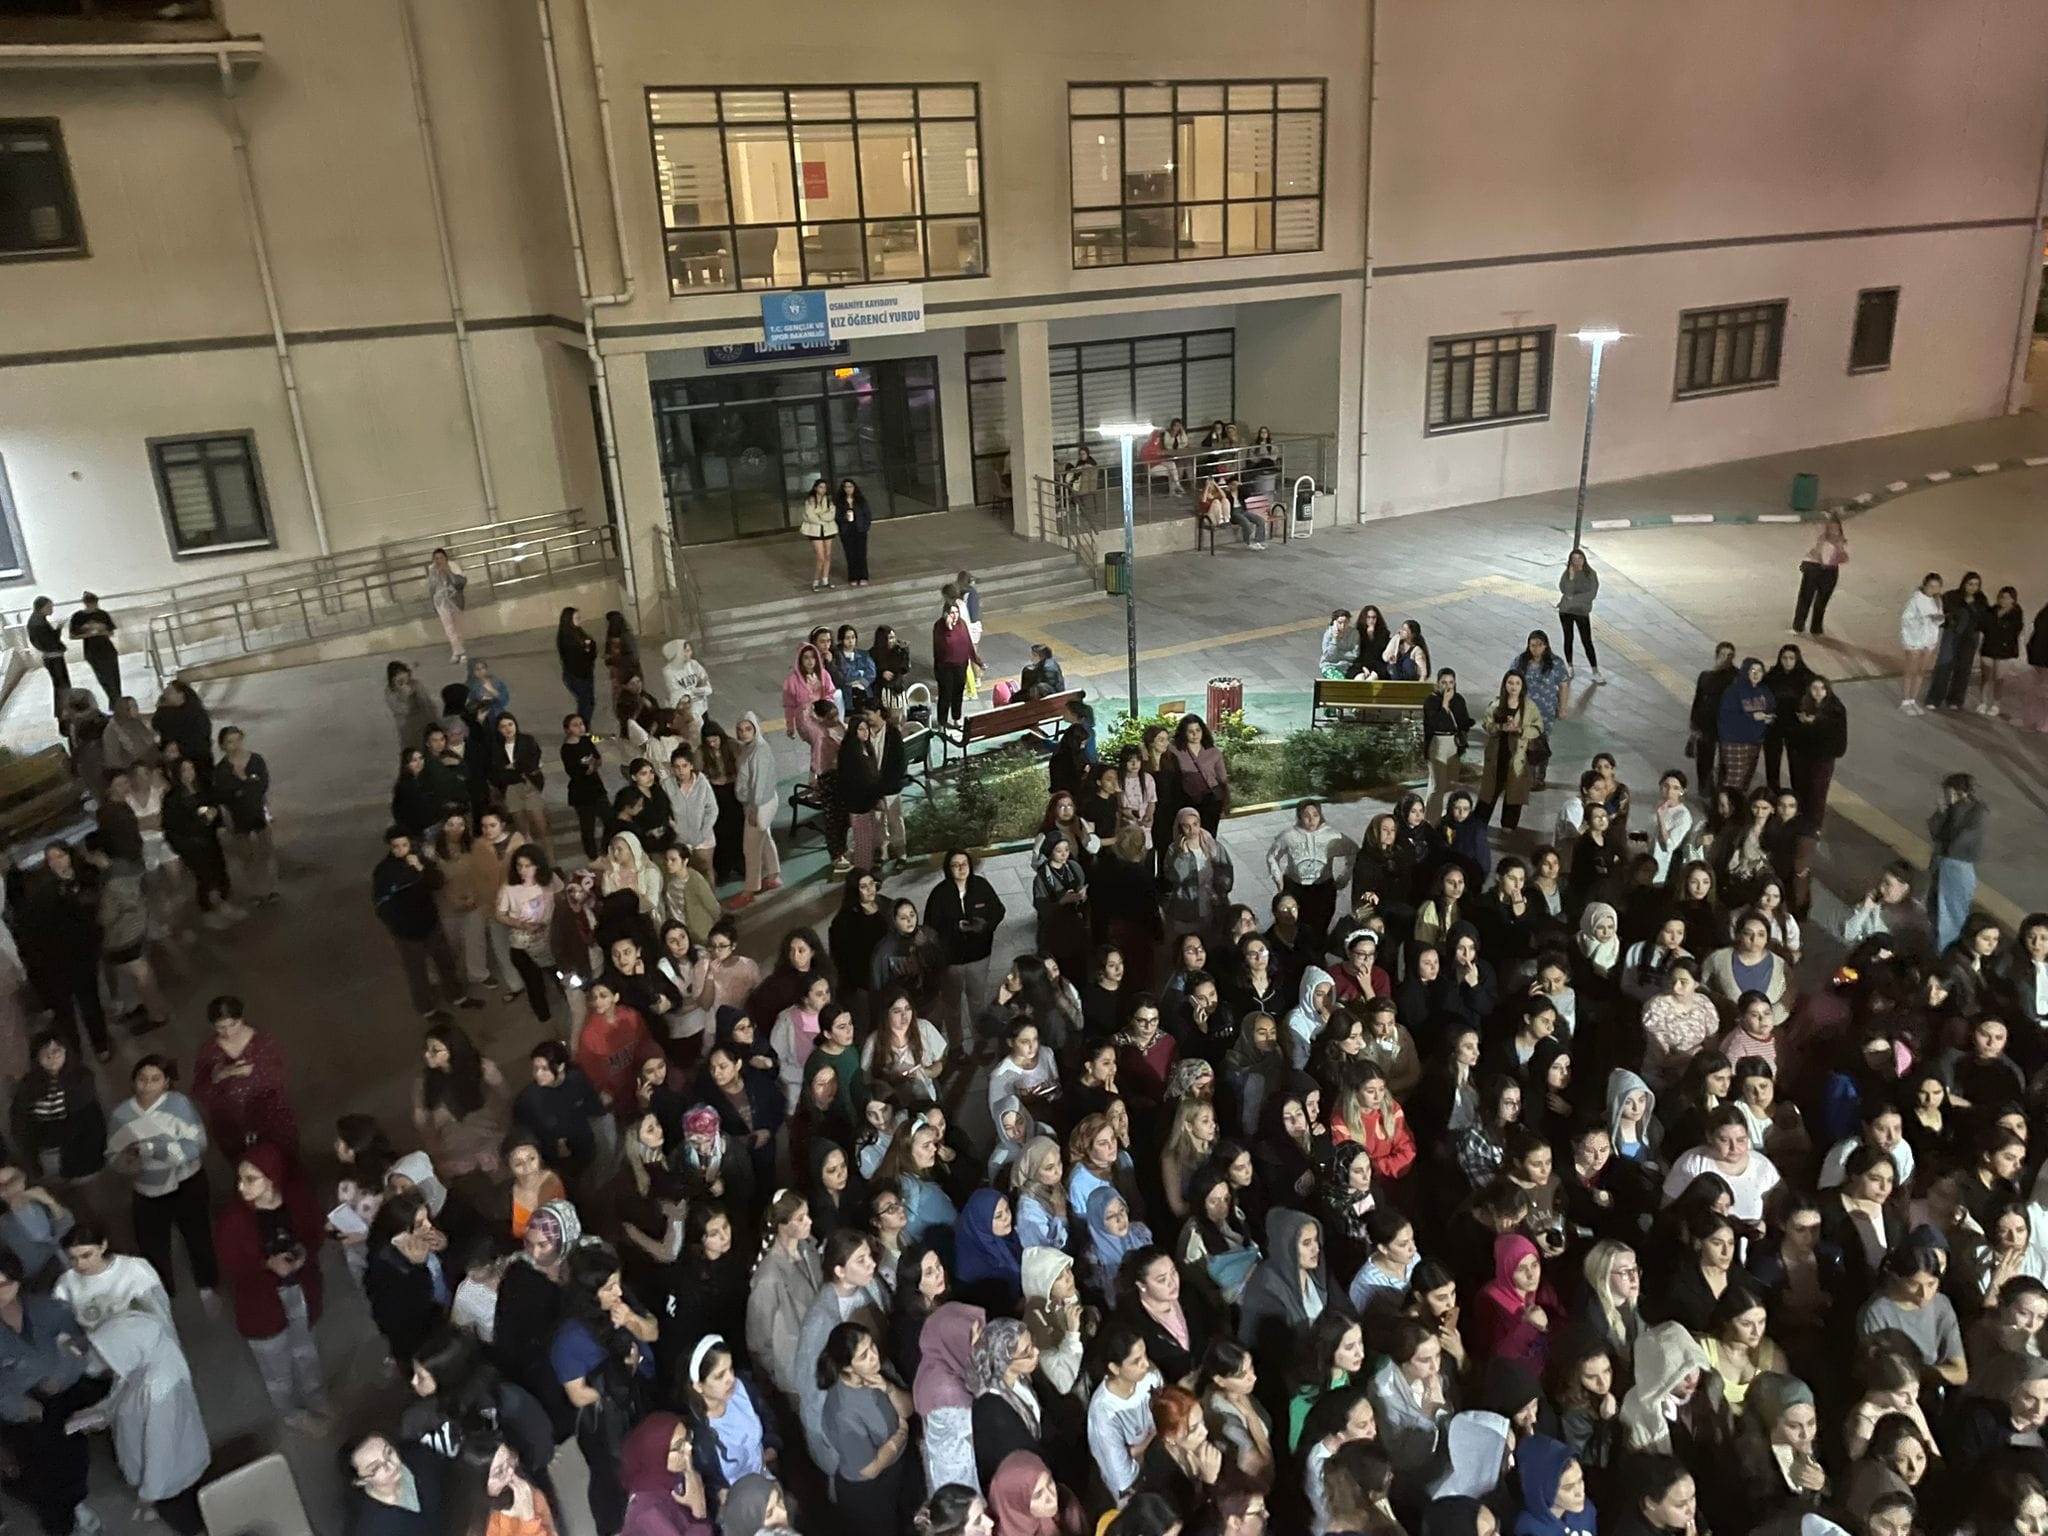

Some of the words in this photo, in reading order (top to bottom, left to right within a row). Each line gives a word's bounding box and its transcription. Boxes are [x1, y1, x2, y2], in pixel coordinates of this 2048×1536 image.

[829, 299, 864, 311] OSMANİYE
[831, 316, 846, 328] KIZ
[847, 311, 887, 326] ÖĞRENCİ
[888, 310, 920, 323] YURDU
